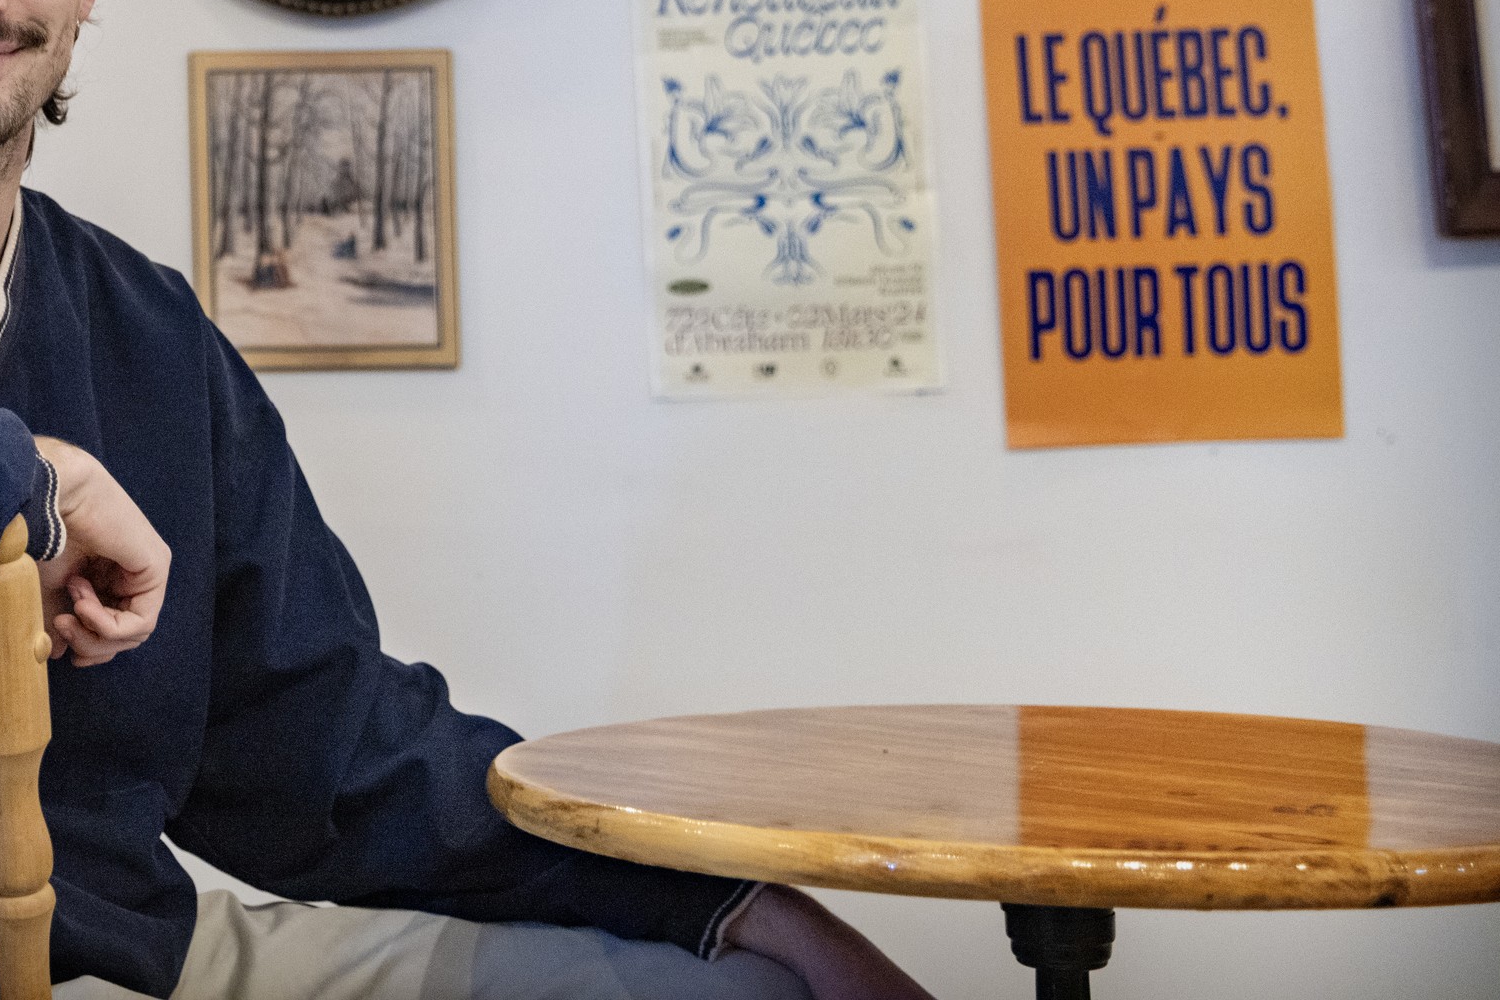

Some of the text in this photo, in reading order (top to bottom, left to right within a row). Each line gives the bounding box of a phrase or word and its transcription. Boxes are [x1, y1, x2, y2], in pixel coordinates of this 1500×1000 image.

[1016, 32, 1071, 124] LE
[1047, 142, 1275, 242] UN PAYS
[1026, 260, 1310, 362] POUR TOUS
